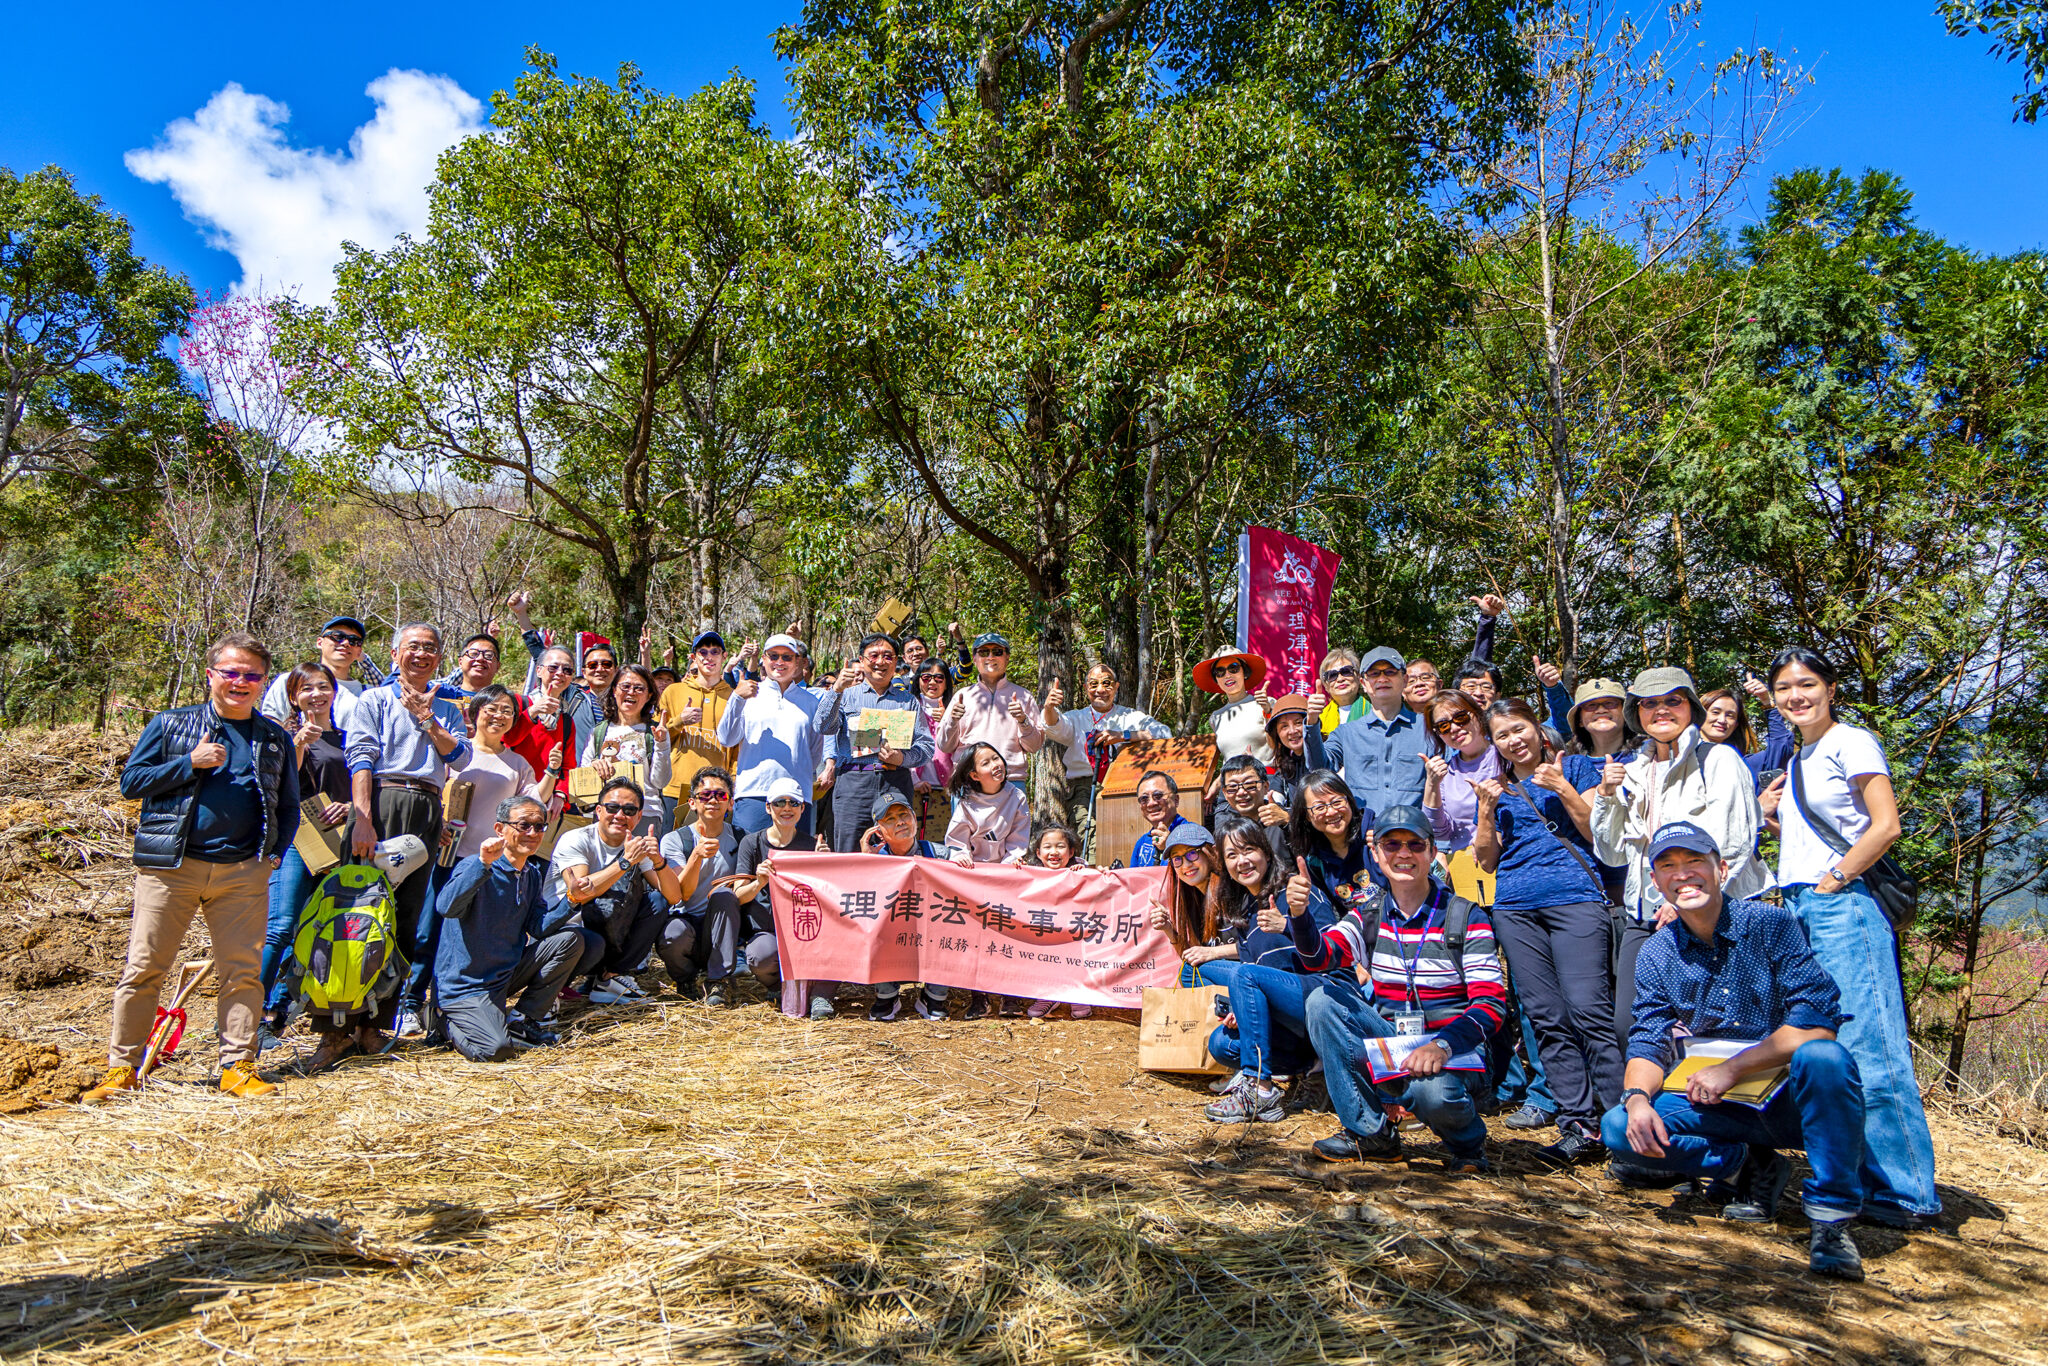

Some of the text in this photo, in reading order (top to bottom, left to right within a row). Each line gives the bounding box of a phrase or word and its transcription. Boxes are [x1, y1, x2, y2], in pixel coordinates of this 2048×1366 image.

[839, 889, 1143, 946] 理律法律事務所
[1019, 950, 1035, 960] we
[1037, 952, 1062, 964] care.
[1065, 956, 1081, 967] we
[1113, 961, 1126, 970] we
[1128, 958, 1156, 970] excel
[1112, 984, 1133, 994] since
